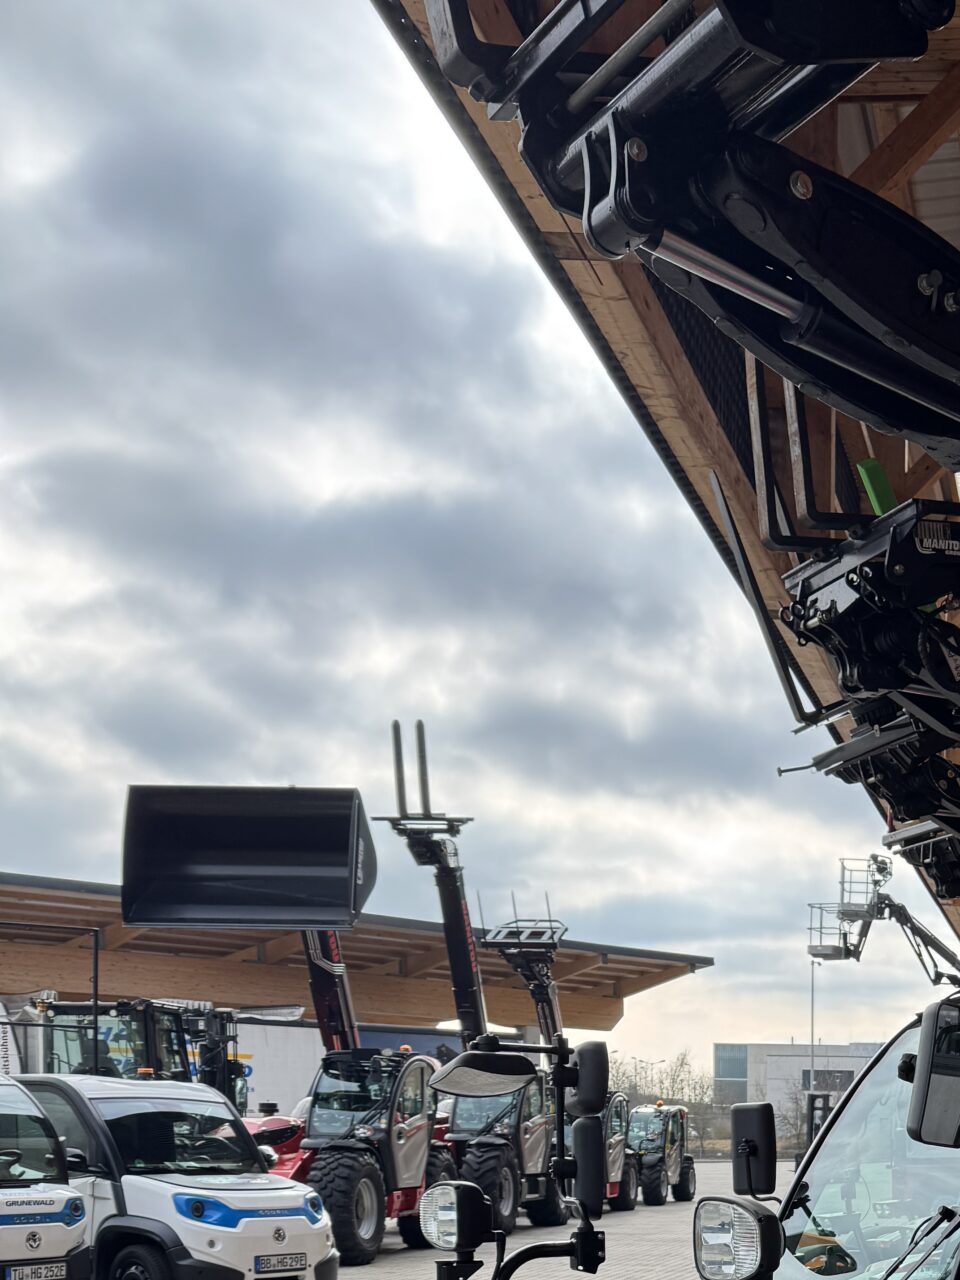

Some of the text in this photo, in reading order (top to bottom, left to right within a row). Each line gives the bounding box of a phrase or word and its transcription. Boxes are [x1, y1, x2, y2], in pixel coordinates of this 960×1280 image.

[5, 1199, 55, 1207] GRUNEWALD
[260, 1258, 271, 1269] BB
[277, 1257, 288, 1267] HG
[12, 1265, 65, 1280] TÜ HG 252E
